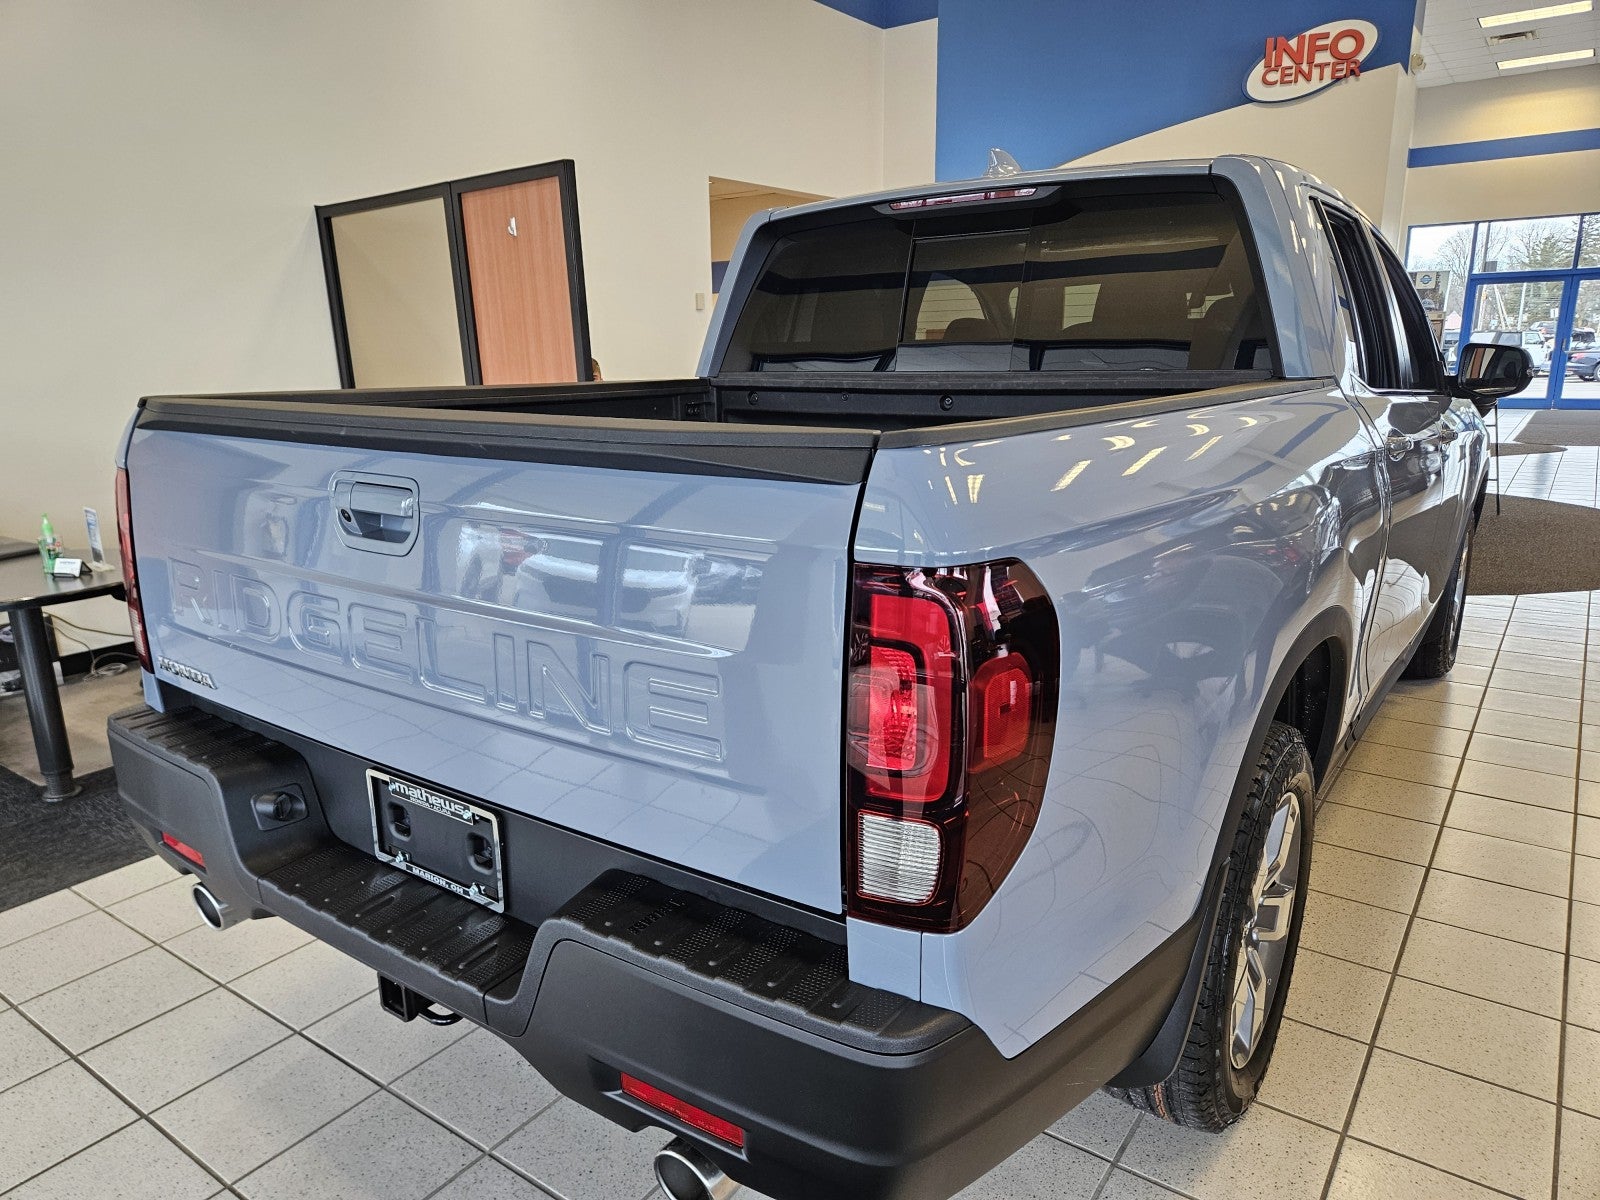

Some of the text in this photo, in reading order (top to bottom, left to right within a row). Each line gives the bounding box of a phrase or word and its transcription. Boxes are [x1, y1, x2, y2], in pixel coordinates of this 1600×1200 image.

[1264, 29, 1365, 68] INFO
[1262, 59, 1361, 86] CENTER
[158, 656, 217, 689] HONDA
[168, 557, 724, 761] RIDGELINE
[395, 782, 465, 815] mathews
[412, 866, 464, 895] MARION, OH
